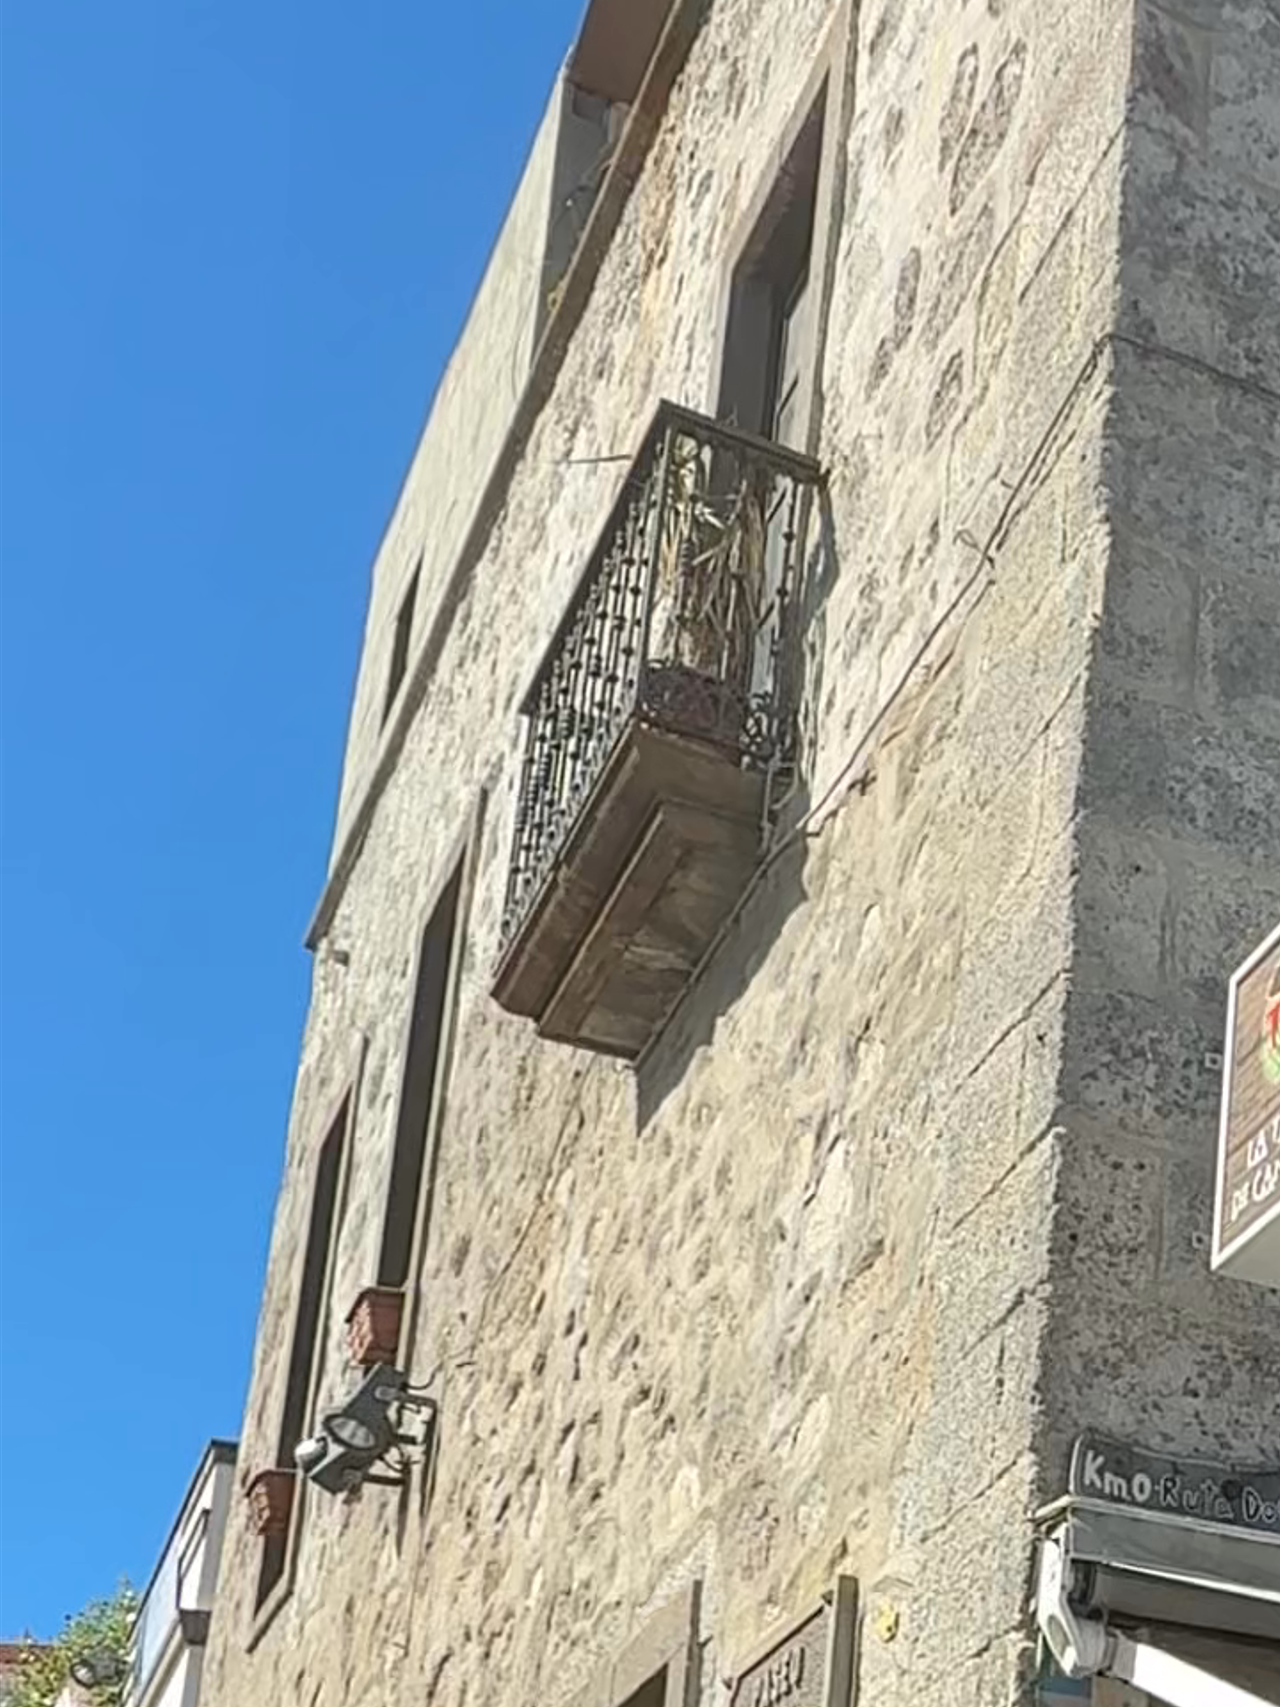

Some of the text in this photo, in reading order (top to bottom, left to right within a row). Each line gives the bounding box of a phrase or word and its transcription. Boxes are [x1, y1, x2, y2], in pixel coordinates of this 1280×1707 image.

[1248, 1129, 1268, 1170] LA
[1231, 1181, 1250, 1222] DE
[1160, 1475, 1233, 1518] Ruta
